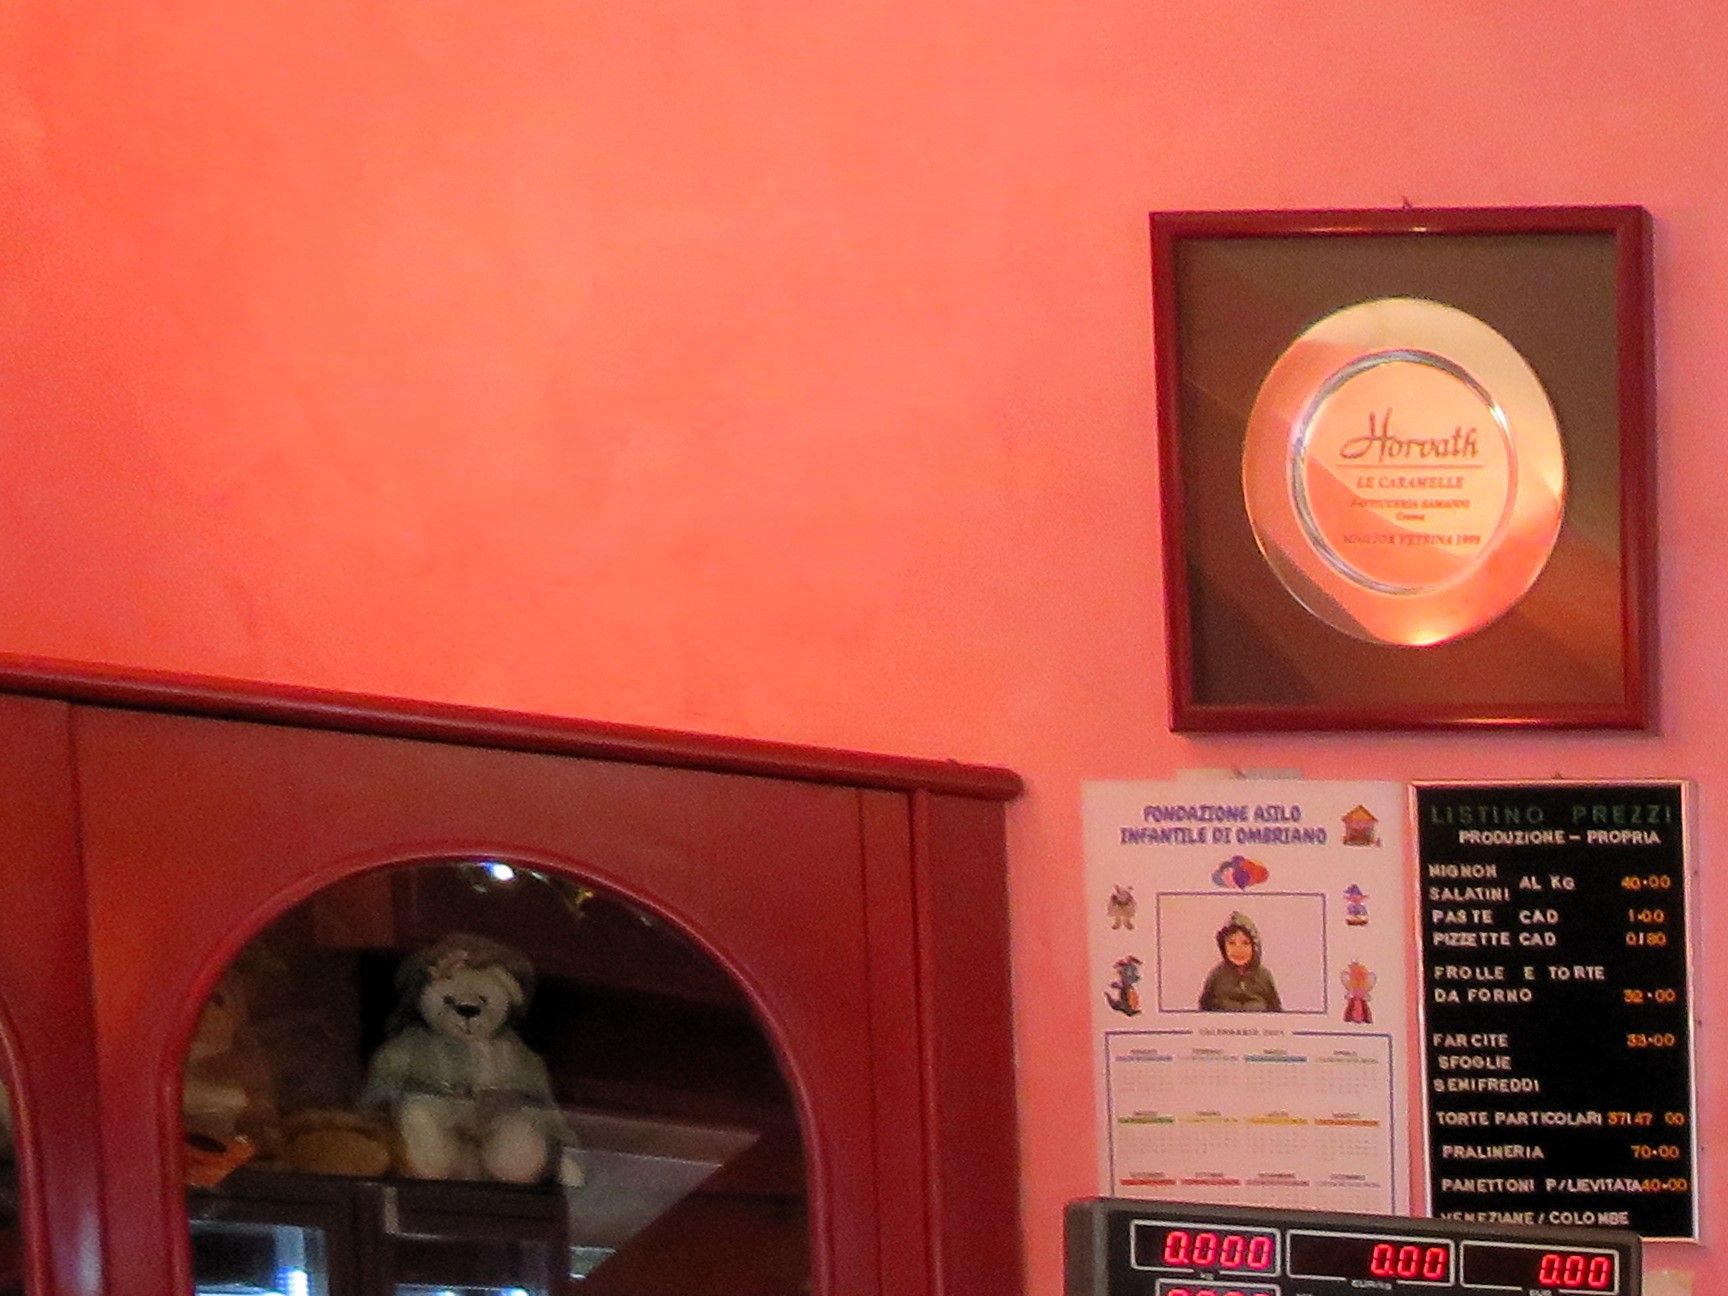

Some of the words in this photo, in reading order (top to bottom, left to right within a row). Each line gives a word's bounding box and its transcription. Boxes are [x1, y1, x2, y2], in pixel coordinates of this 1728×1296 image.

[1339, 407, 1479, 462] Horvath
[1143, 804, 1248, 823] FONDAZIONE
[1253, 804, 1302, 822] ASILO
[1430, 805, 1545, 825] LISTINO
[1572, 804, 1673, 824] PREZZI
[1119, 826, 1206, 845] INFANTILE
[1212, 827, 1232, 844] DI
[1236, 827, 1328, 846] OMBRIANO
[1458, 829, 1566, 845] PRODUZIONE
[1587, 829, 1662, 845] PROPRIA
[1519, 875, 1542, 890] AL
[1549, 875, 1576, 890] KG
[1428, 886, 1511, 901] SALATINI
[1432, 909, 1494, 924] PASTE
[1519, 909, 1559, 924] CAD
[1433, 931, 1511, 946] PIZZETTE
[1519, 931, 1557, 946] CAD
[1434, 965, 1505, 981] FROLLE
[1523, 966, 1536, 980] E
[1549, 965, 1606, 980] TORTE
[1434, 988, 1461, 1003] DA
[1467, 988, 1533, 1003] FORNO
[1433, 1033, 1509, 1048] FARCITE
[1437, 1055, 1512, 1070] SFOGLIE
[1433, 1077, 1540, 1093] SEMIFREDDI
[1436, 1111, 1489, 1127] TORTE
[1494, 1111, 1603, 1127] PARTICOLARI
[1442, 1145, 1545, 1161] PRALINERIA
[1441, 1178, 1536, 1193] PANETTONI
